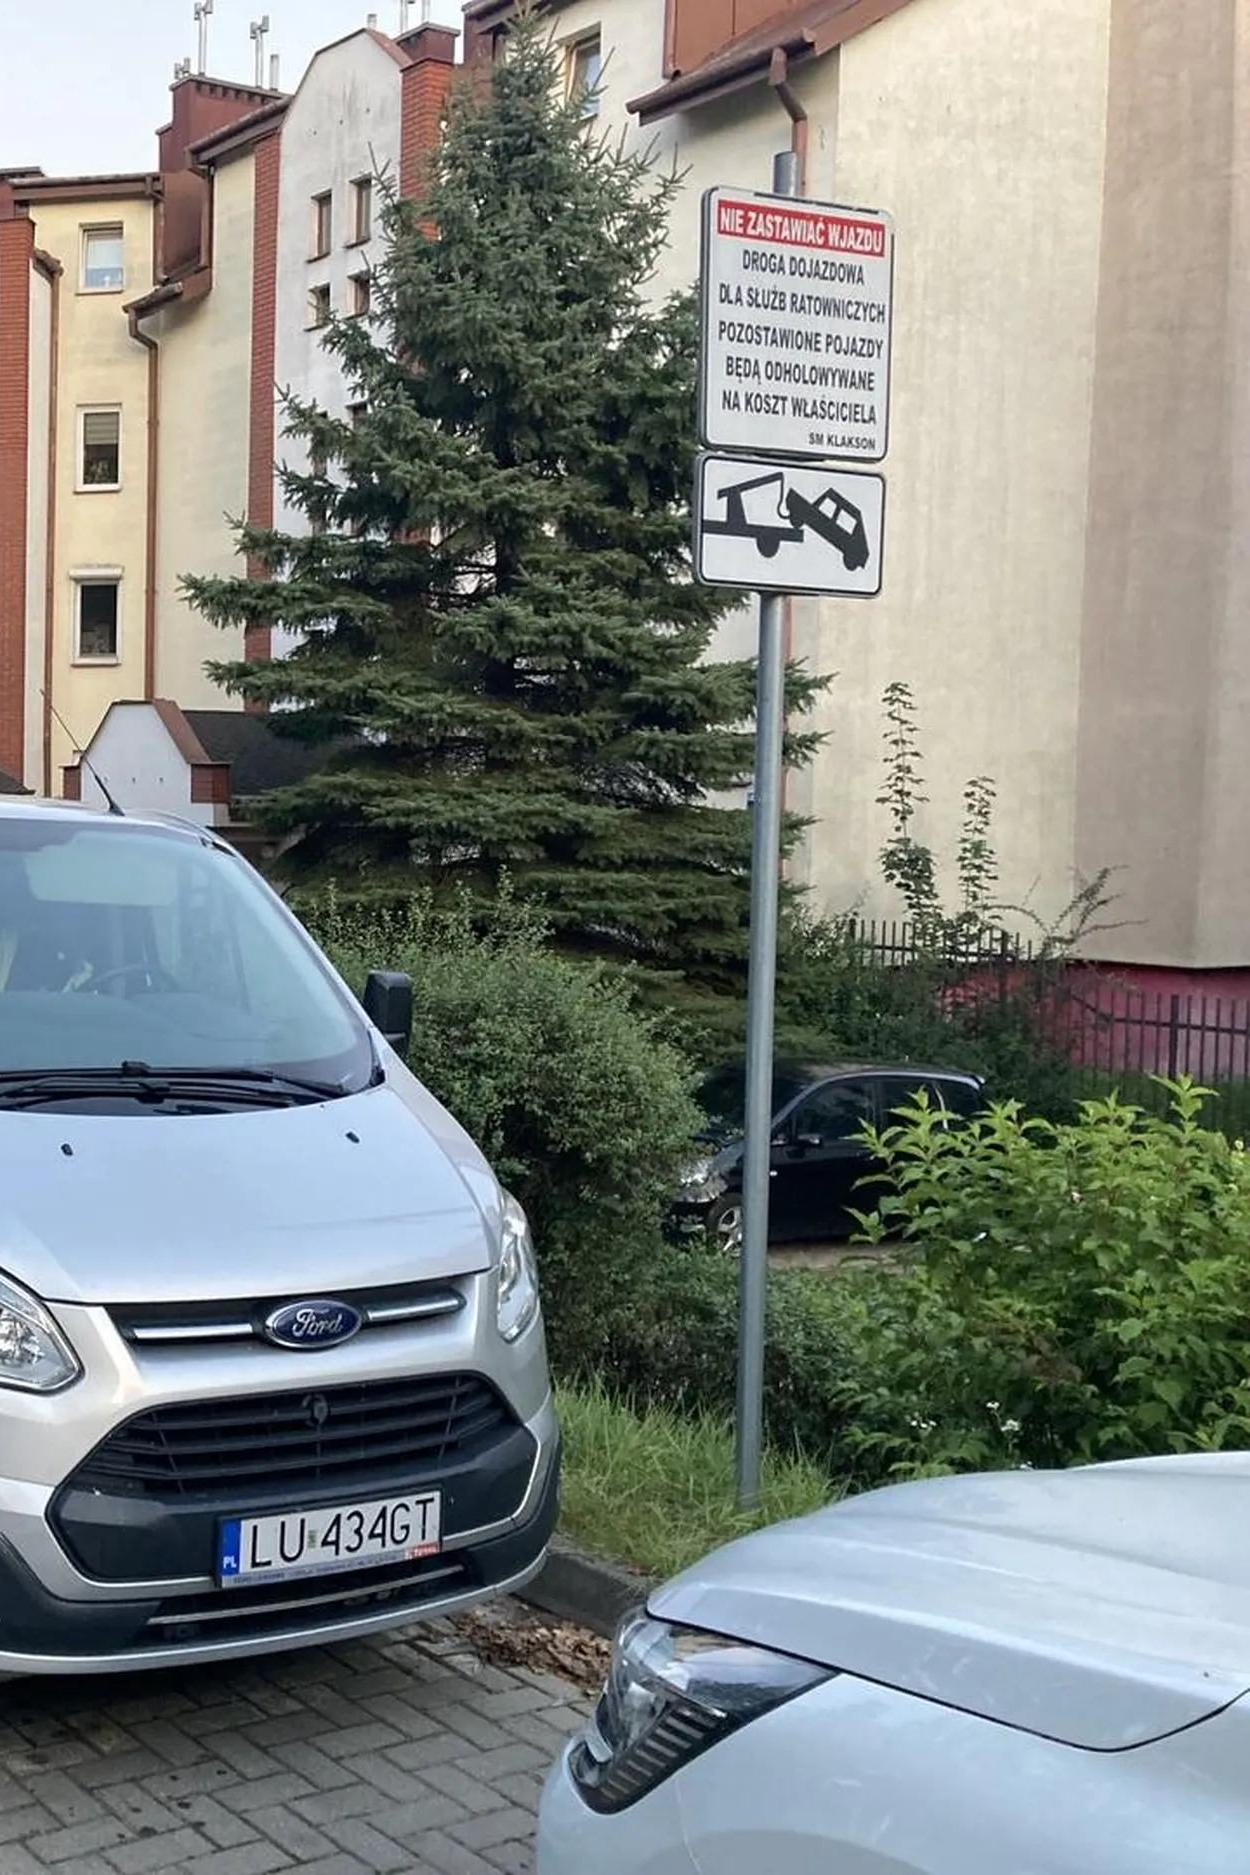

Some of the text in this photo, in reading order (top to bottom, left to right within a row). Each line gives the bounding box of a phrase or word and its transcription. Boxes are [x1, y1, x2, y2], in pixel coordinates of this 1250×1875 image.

[720, 207, 884, 252] NIE ZASTAWIAĆ WJAZDU
[743, 250, 865, 285] DROGA DOJAZDOWA
[719, 283, 886, 323] DLA SŁUŻB RATOWNICZYCH
[718, 320, 884, 359] POZOSTAWIONE POJAZDY
[726, 356, 875, 391] BĘDĄ ODHOLOWYWANE
[722, 389, 876, 424] NA KOSZT WŁAŚCICIELA
[809, 432, 876, 450] SM KLAKSON
[291, 1308, 343, 1337] Ford
[250, 1497, 435, 1569] LU 434GT
[223, 1556, 237, 1569] PL
